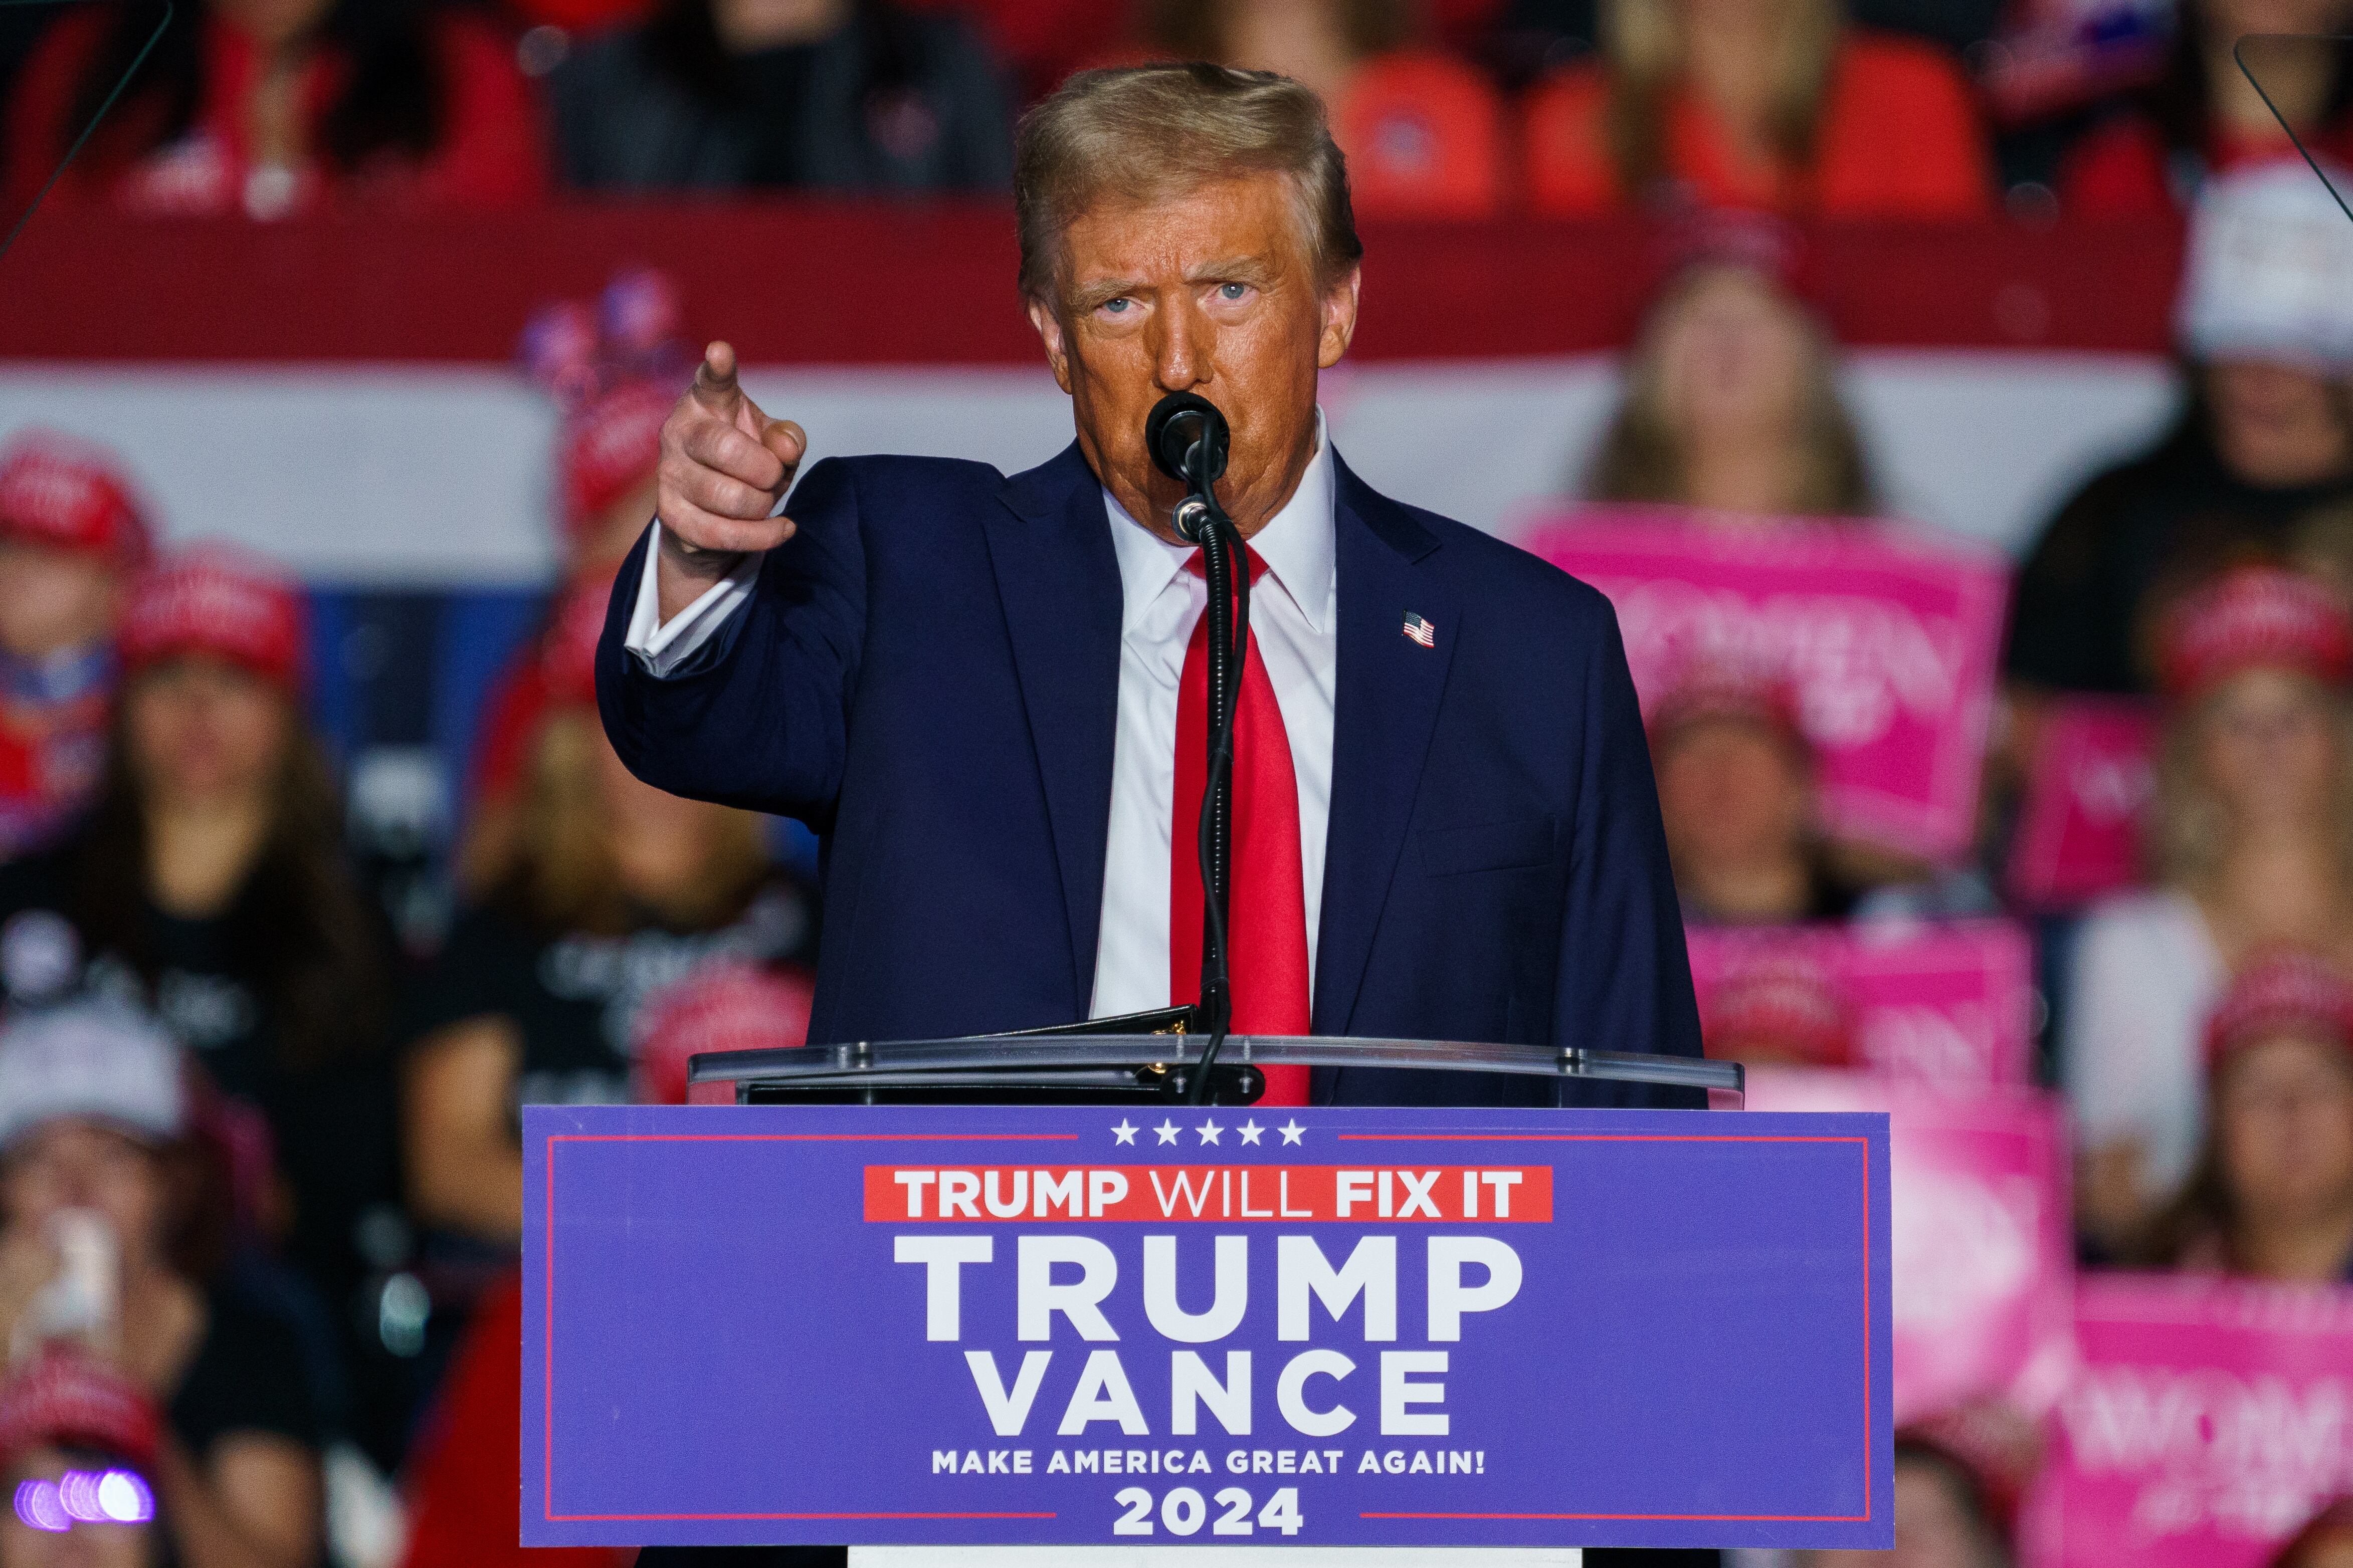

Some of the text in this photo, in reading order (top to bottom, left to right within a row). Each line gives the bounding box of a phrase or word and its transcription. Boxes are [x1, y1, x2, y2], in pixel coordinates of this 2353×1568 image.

[895, 1171, 1522, 1218] TRUMP WILL FIX IT
[894, 1235, 1523, 1342] TRUMP
[964, 1350, 1449, 1436] VANCE
[933, 1450, 1484, 1474] MAKE AMERICA GREAT AGAIN!
[1113, 1487, 1303, 1535] 2024
